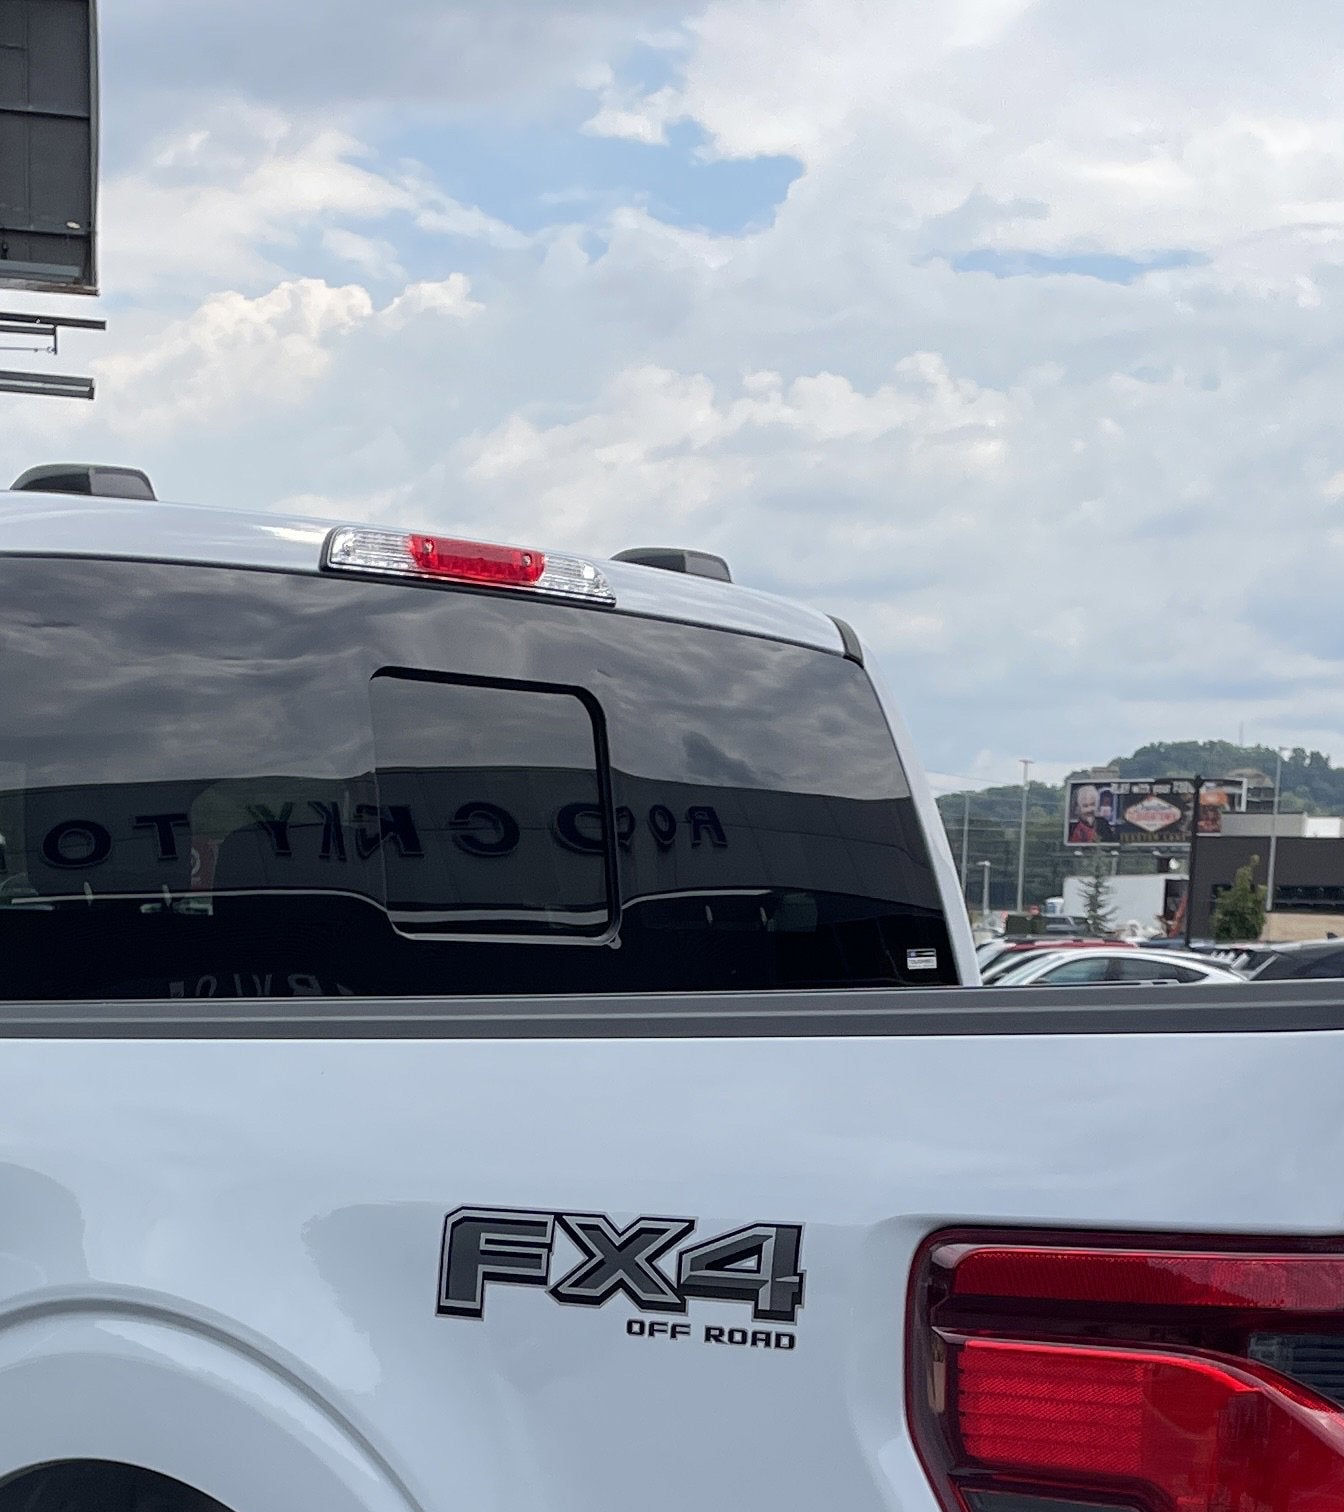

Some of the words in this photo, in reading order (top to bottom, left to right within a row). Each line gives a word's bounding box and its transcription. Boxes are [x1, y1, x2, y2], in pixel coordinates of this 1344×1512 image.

[435, 1205, 806, 1324] FX4
[627, 1319, 690, 1341] OFF
[703, 1324, 797, 1351] ROAD
